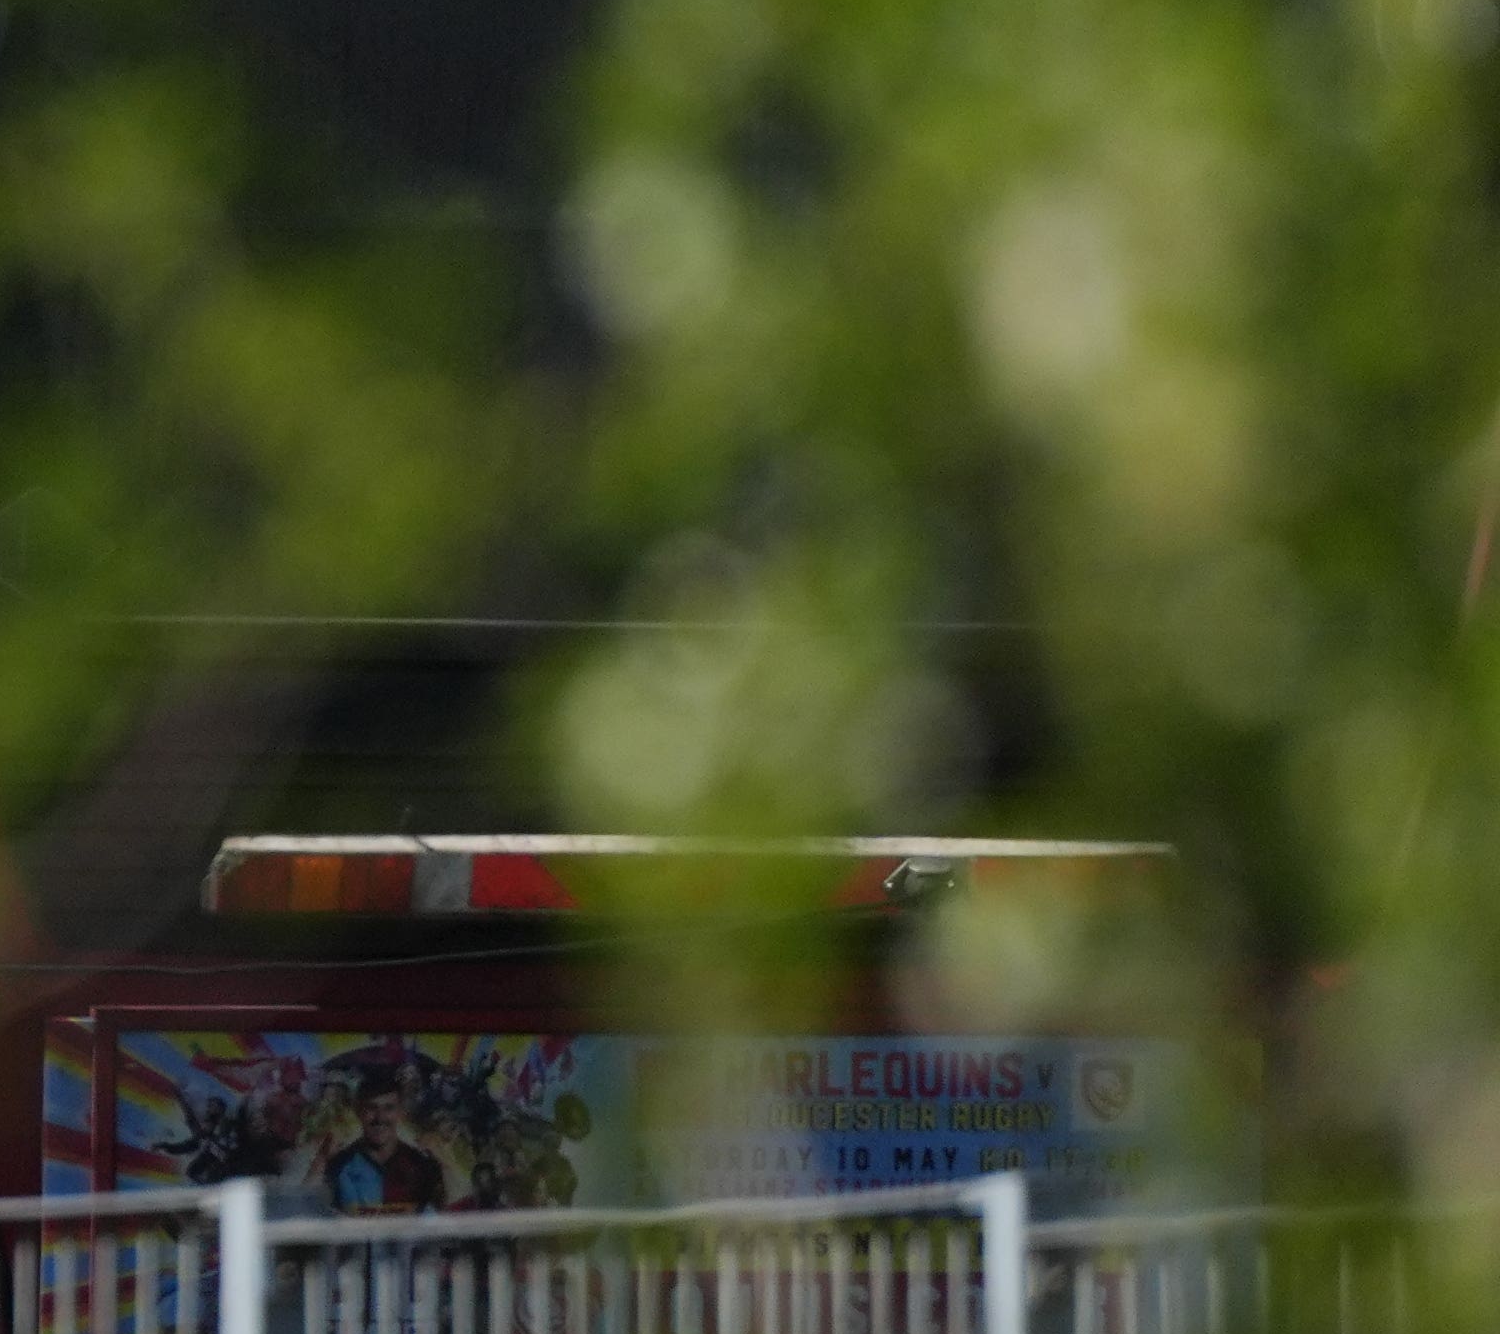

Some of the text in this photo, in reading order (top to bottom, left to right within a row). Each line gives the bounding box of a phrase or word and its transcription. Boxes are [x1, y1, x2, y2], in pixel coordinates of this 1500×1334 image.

[951, 1100, 1055, 1133] RUGBY
[836, 1146, 872, 1173] 10
[893, 1146, 962, 1173] MAY
